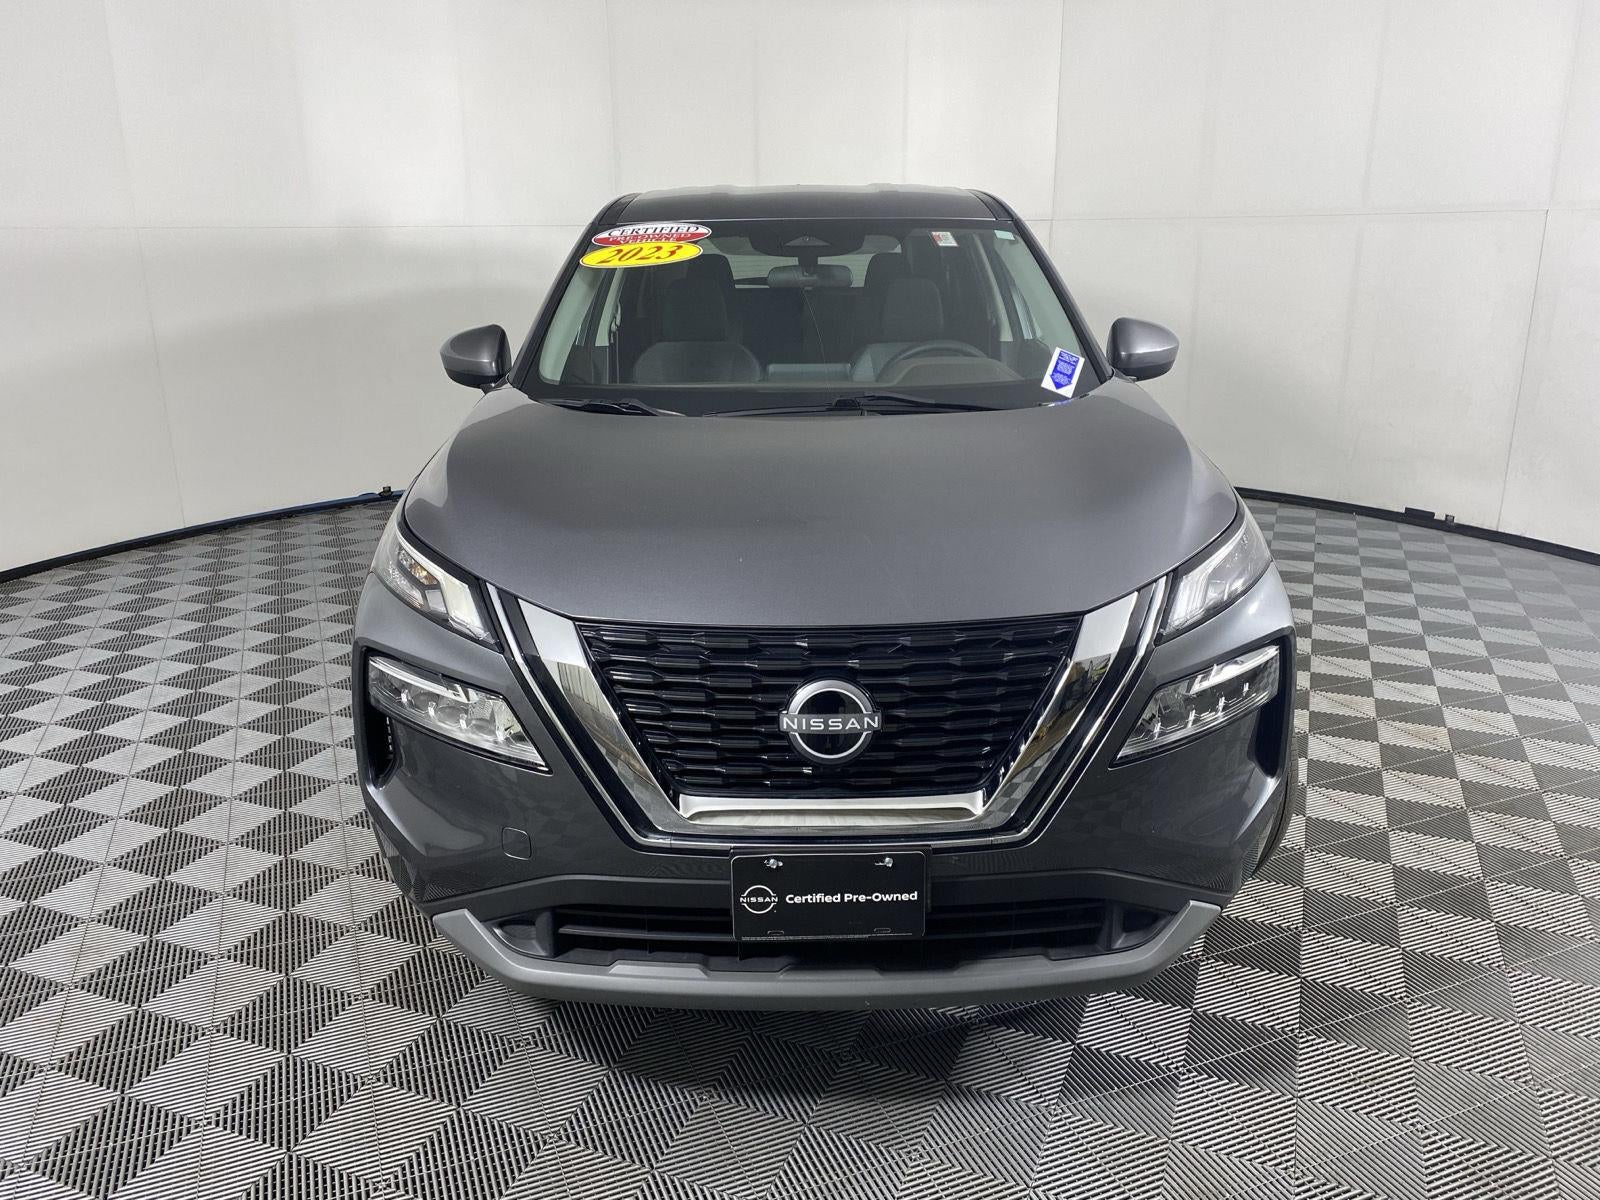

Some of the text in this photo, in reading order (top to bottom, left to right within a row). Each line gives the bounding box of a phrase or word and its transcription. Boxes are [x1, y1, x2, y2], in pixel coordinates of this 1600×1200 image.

[608, 225, 700, 237] CERTIFIED
[597, 245, 683, 264] 2023
[783, 716, 879, 730] NISSAN
[785, 891, 918, 904] Certified Pre-Owned
